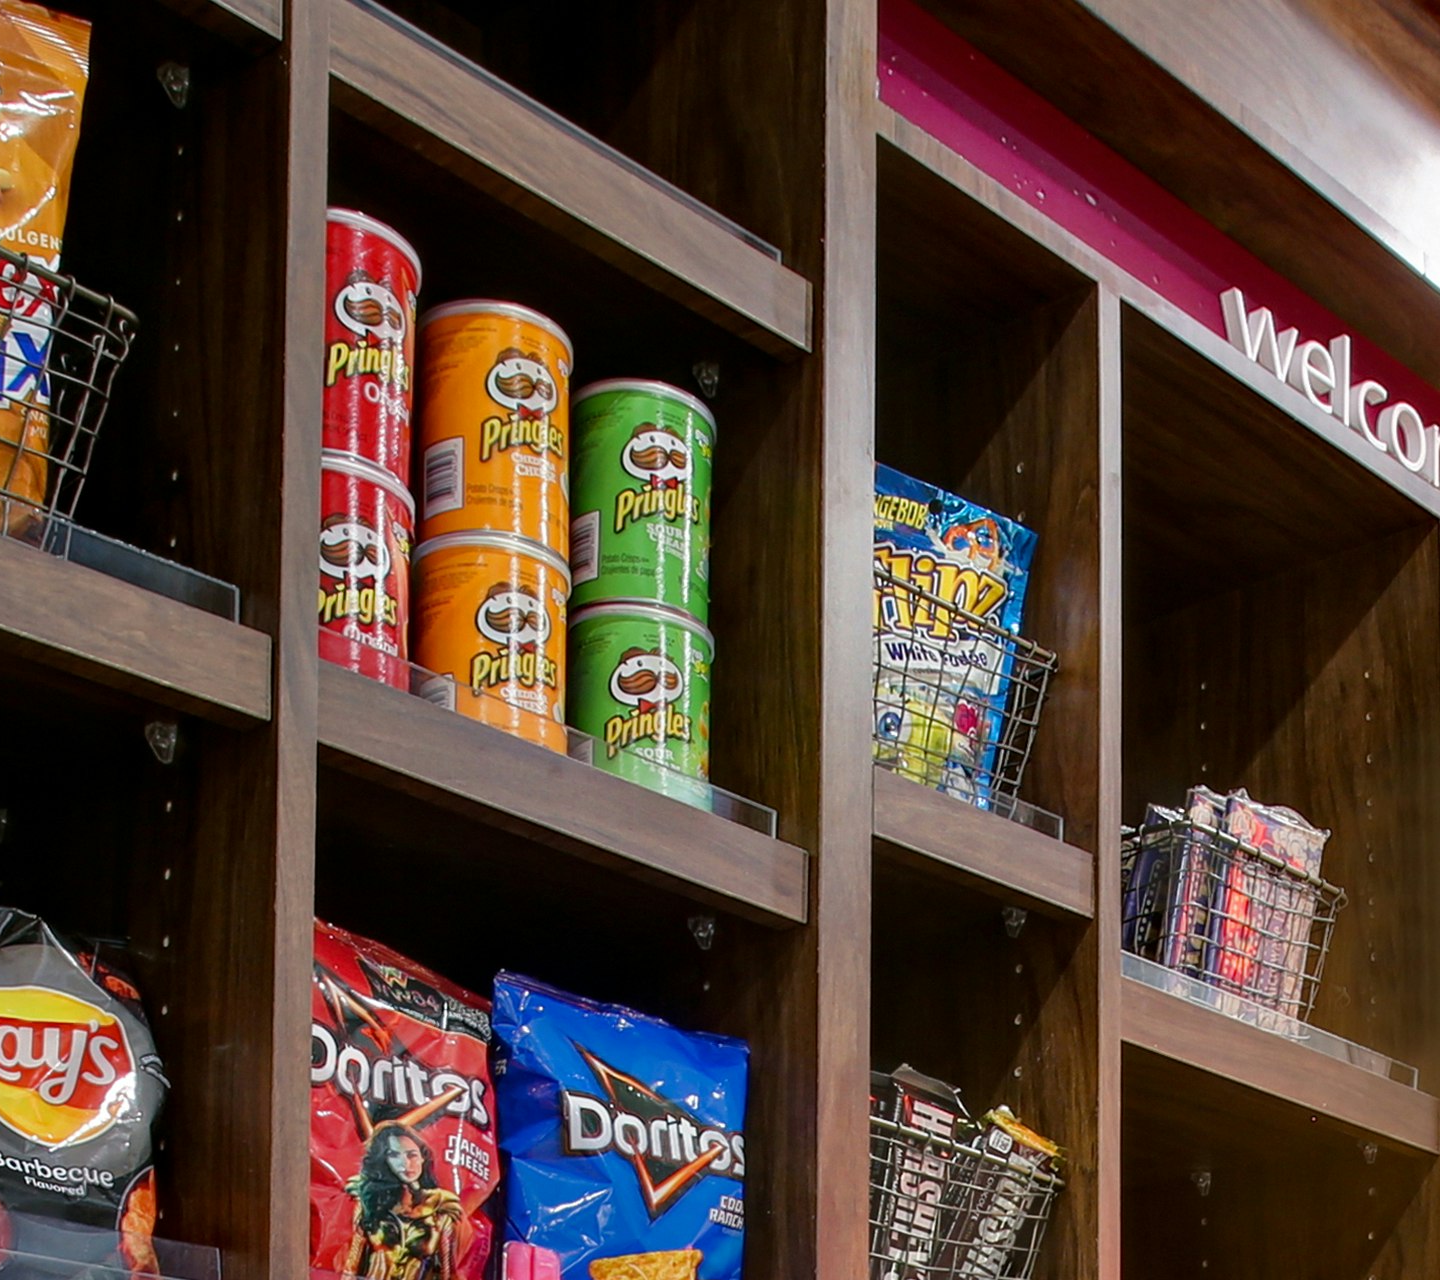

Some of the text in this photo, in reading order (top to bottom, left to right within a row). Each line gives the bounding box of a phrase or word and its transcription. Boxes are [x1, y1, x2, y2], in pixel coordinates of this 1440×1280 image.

[312, 1026, 489, 1129] Doritos
[568, 1096, 745, 1178] Doritos
[24, 1175, 85, 1198] Flavored
